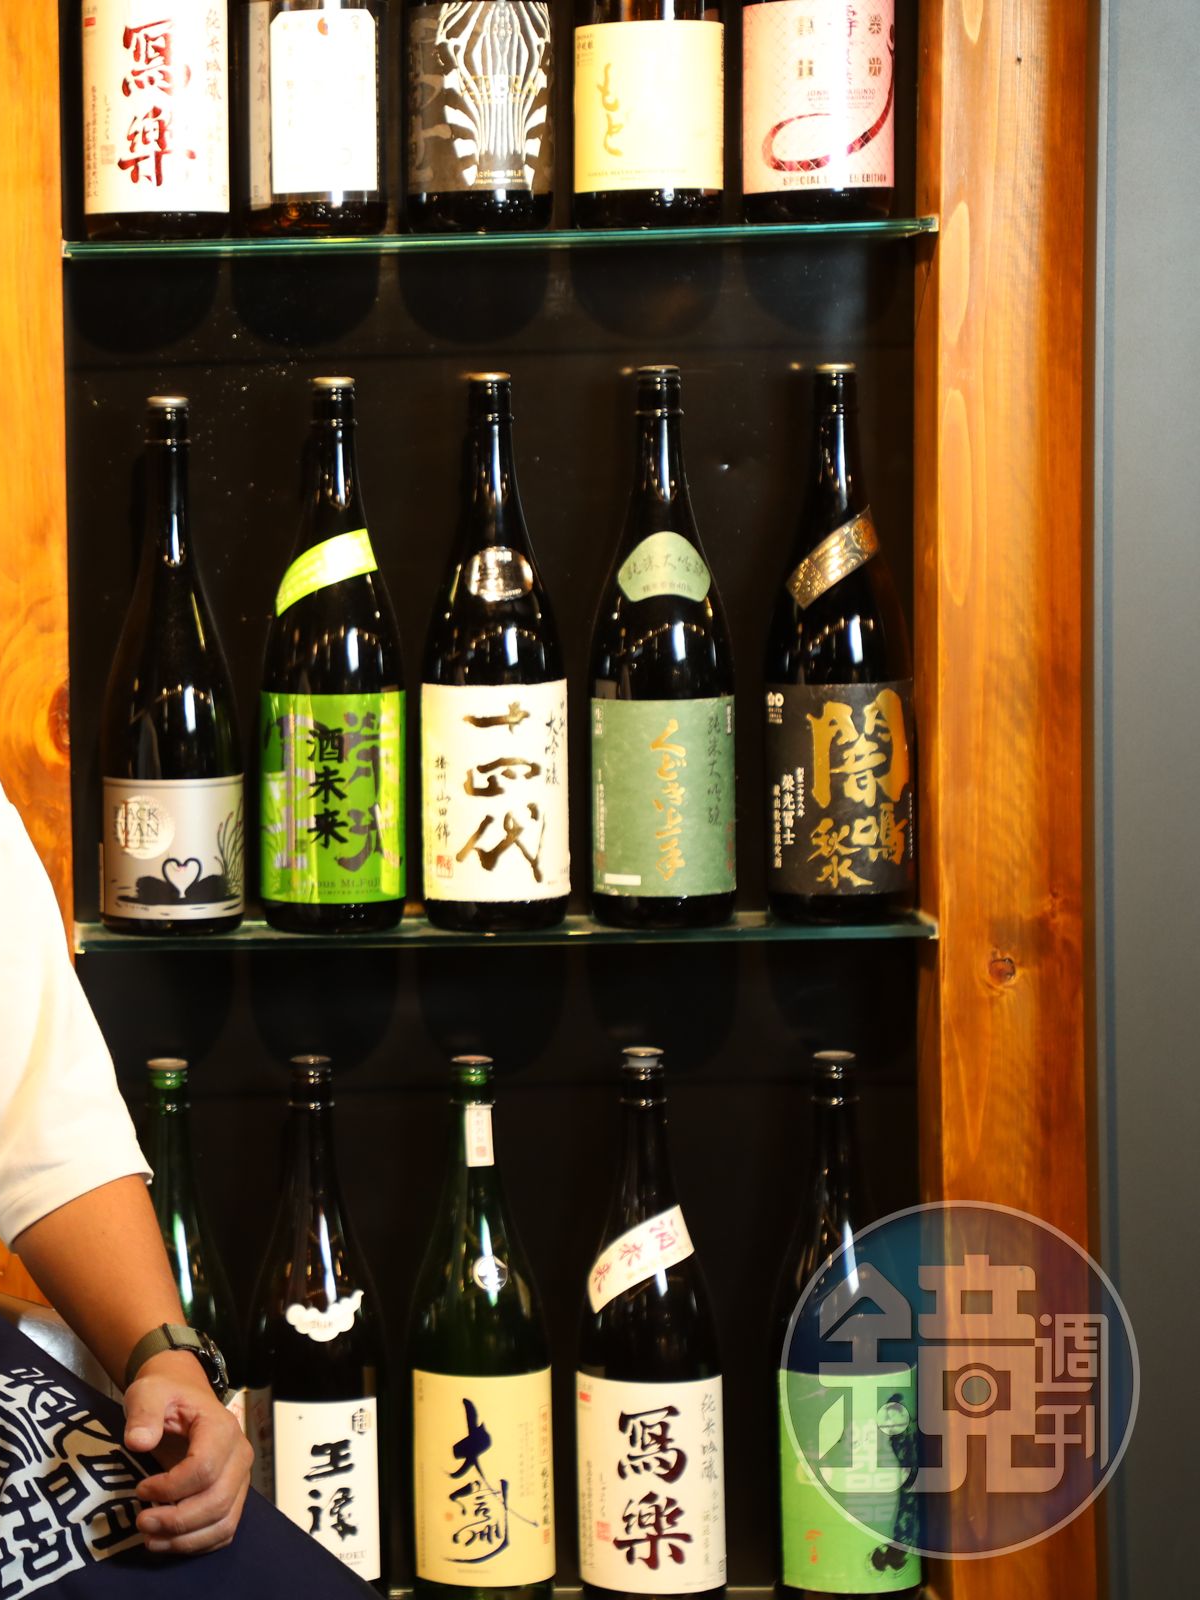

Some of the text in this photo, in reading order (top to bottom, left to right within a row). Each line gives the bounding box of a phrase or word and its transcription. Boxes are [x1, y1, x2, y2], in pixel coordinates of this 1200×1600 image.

[306, 727, 349, 849] 酒未来
[455, 701, 546, 883] 十四代
